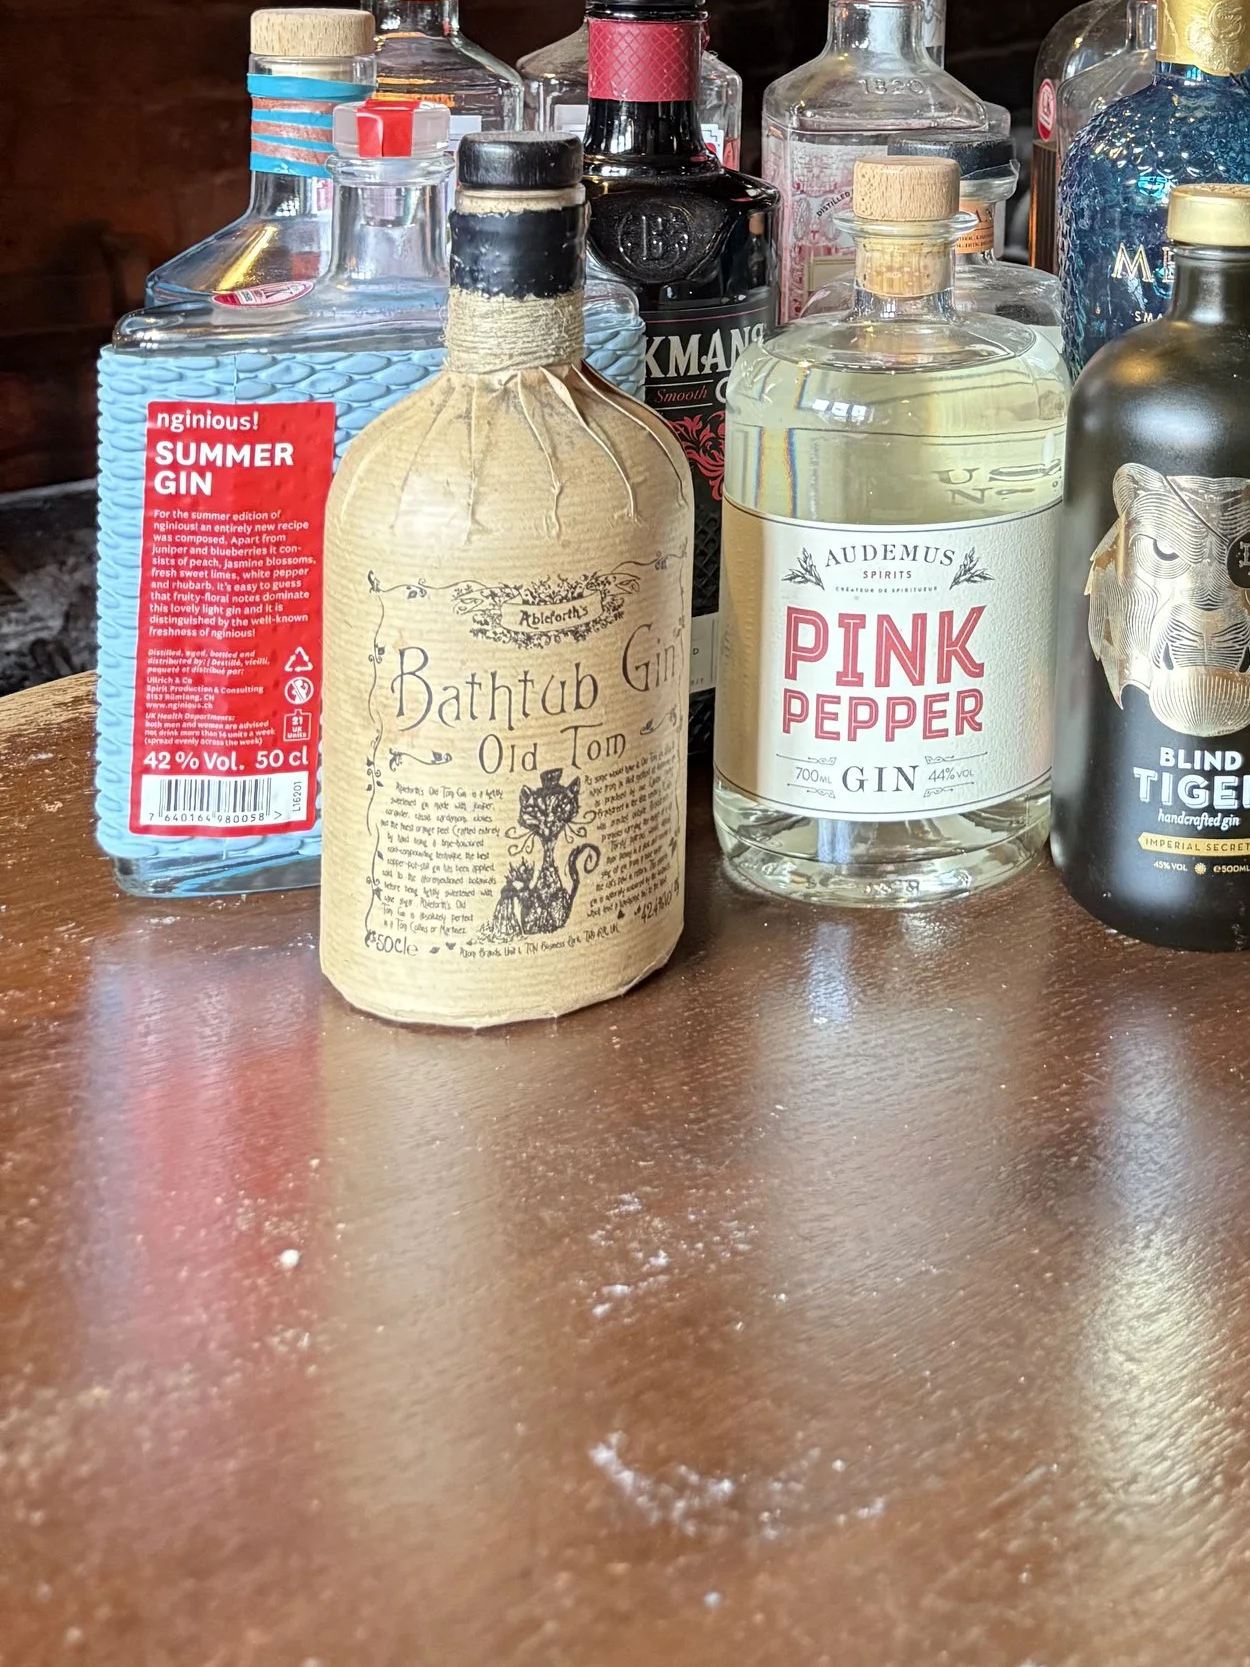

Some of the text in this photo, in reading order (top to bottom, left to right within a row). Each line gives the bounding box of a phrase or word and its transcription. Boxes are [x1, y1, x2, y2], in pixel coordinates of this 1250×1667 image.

[859, 79, 925, 95] 1820
[817, 191, 850, 217] DISTILLED
[655, 385, 708, 403] Smooth
[157, 410, 258, 432] nginious!
[155, 441, 294, 468] SUMMER
[154, 470, 212, 496] GIN
[154, 509, 281, 521] For the summer edition of
[214, 523, 251, 533] entirely
[278, 521, 309, 531] recipe
[153, 533, 286, 546] was Apart from
[152, 545, 267, 556] juniper and blueberries
[825, 544, 956, 567] AUDEMUS
[152, 558, 263, 568] sists of jasmine
[151, 568, 309, 580] fresh sweet white pepper
[863, 570, 912, 579] SPIRITS
[151, 580, 302, 592] and easy to guess
[151, 591, 309, 603] that fruity-floral notes dominate
[150, 603, 283, 616] this lovely light gin and it is
[519, 606, 589, 630] Ableforth's
[150, 614, 309, 627] distinguished by the well-known
[149, 627, 256, 639] freshness of nginious!
[784, 605, 987, 688] PINK
[391, 622, 676, 732] Bathtub Gin
[782, 687, 984, 743] PEPPER
[478, 721, 626, 774] Old Tom
[143, 745, 308, 771] 42 % Vol. 50 cl
[1160, 747, 1244, 771] BLIND
[842, 765, 920, 793] GIN
[292, 781, 302, 812] L16201
[164, 813, 211, 822] 640164
[217, 812, 265, 824] 980058
[1158, 808, 1240, 831] handcrafted gin
[1145, 836, 1199, 852] IMPERIAL
